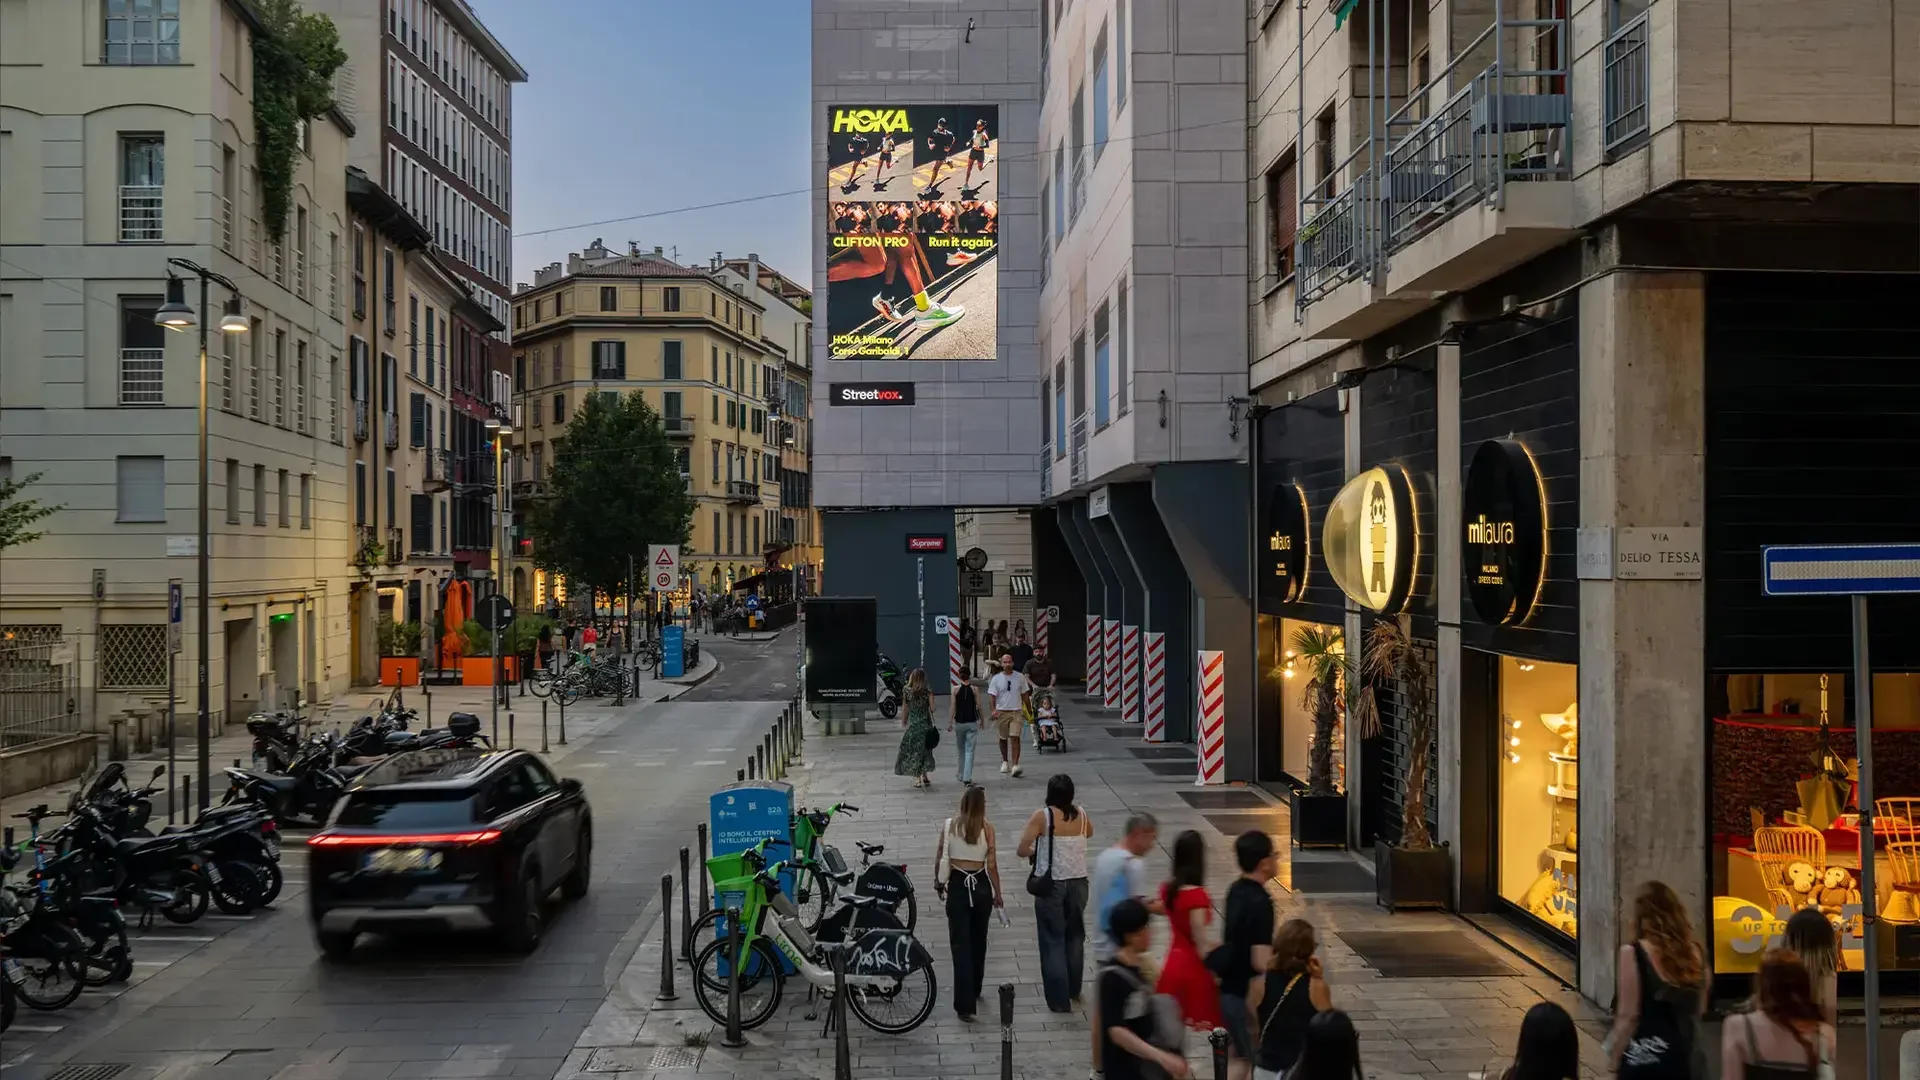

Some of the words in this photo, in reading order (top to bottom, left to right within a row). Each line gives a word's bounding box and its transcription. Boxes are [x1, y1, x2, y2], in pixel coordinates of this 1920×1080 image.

[833, 109, 910, 133] HOKA
[833, 236, 881, 248] CLIFTON
[884, 236, 909, 248] PRO
[928, 236, 949, 248] Run
[951, 236, 959, 248] it
[961, 236, 993, 250] again
[832, 335, 860, 345] HOKA
[862, 335, 894, 345] Milano
[832, 346, 857, 356] Corso
[858, 346, 902, 357] Garibaldi,
[904, 347, 909, 355] 1
[842, 388, 903, 400] Streetvox.
[1468, 514, 1514, 545] milaura
[1651, 533, 1669, 541] VIA
[912, 538, 942, 549] Supreme
[1620, 553, 1652, 563] DELIO
[1659, 551, 1701, 564] TESSA
[753, 829, 782, 837] CESTINO
[1743, 922, 1763, 934] UP
